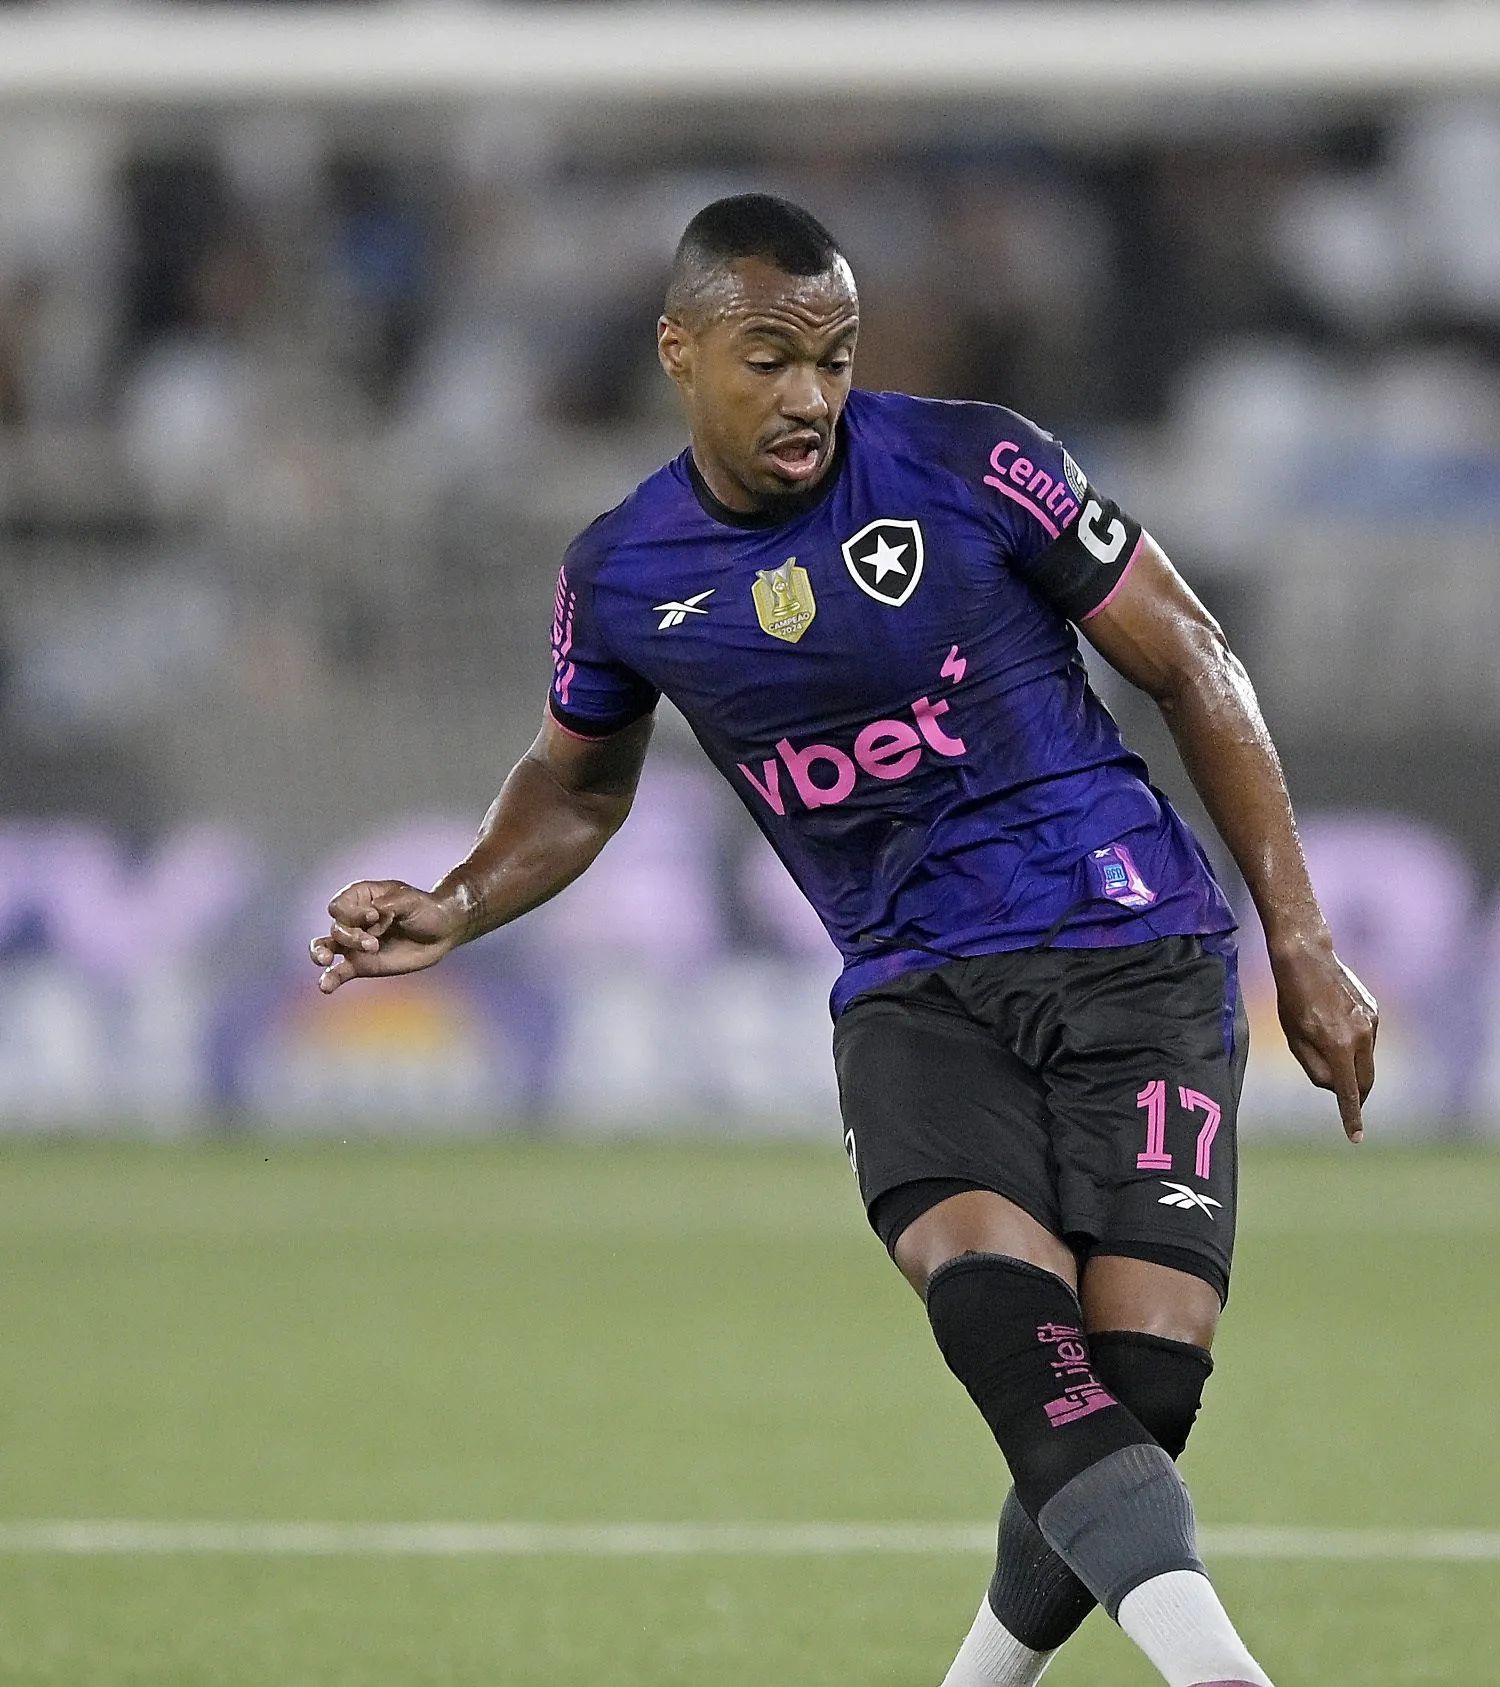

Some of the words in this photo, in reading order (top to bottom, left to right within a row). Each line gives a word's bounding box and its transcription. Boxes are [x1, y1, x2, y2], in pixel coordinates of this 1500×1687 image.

[1077, 499, 1127, 564] C
[737, 696, 967, 816] vbet
[1136, 1080, 1221, 1180] 17
